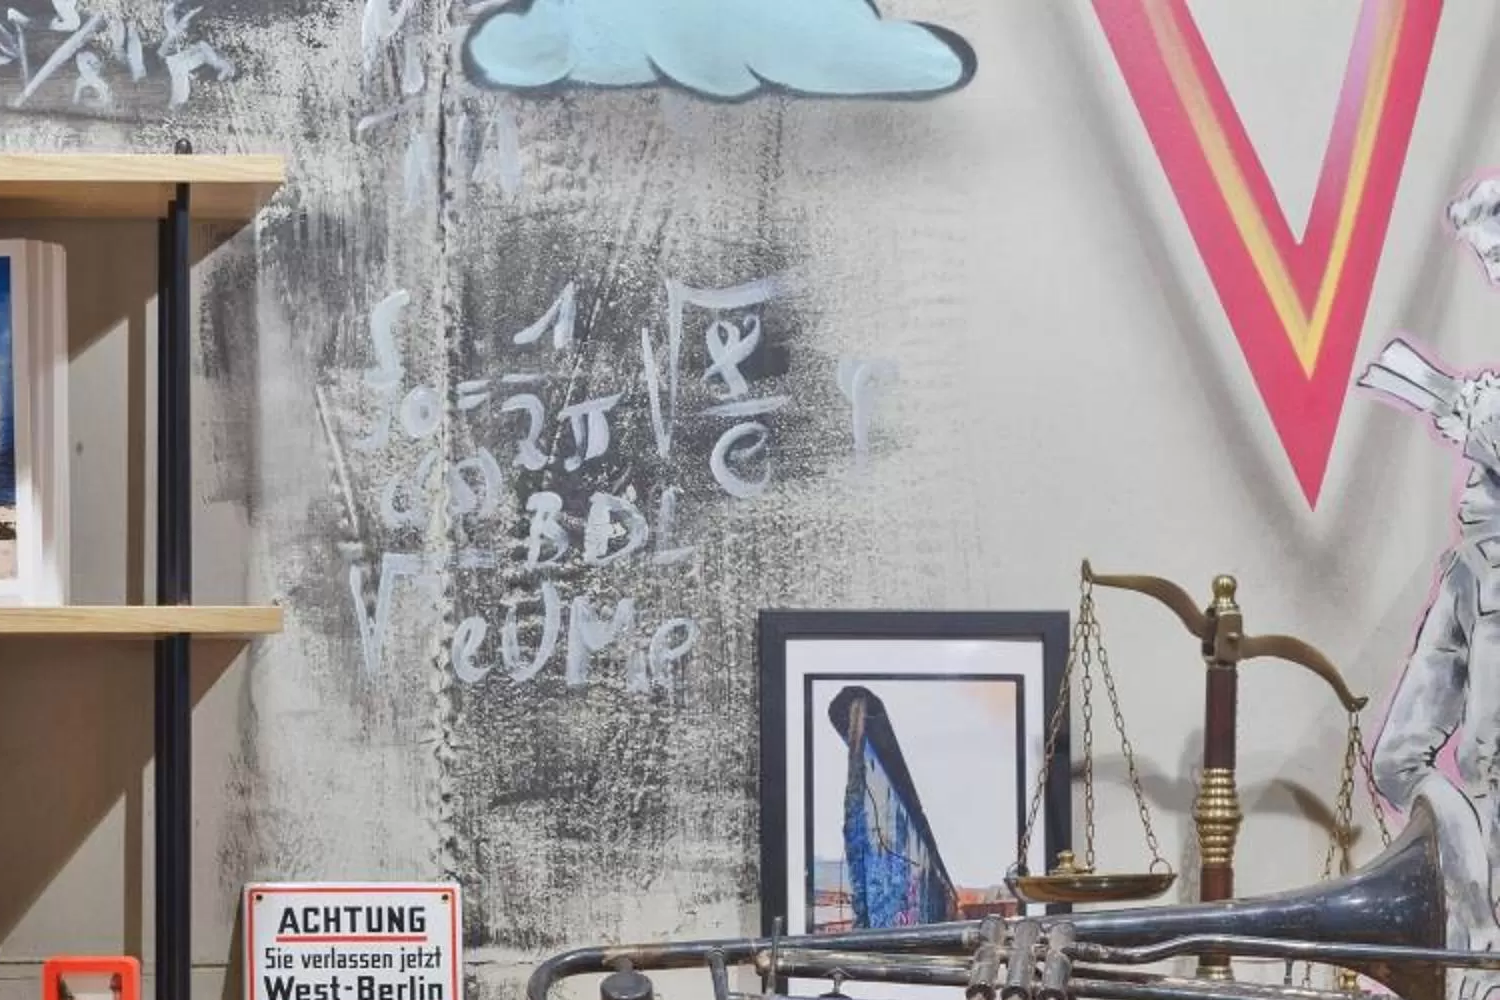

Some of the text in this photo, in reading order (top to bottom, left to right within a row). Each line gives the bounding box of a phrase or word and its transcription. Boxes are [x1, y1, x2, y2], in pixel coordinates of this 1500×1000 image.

[277, 906, 426, 934] ACHTUNG
[264, 946, 442, 973] Sie verlassen jetzt
